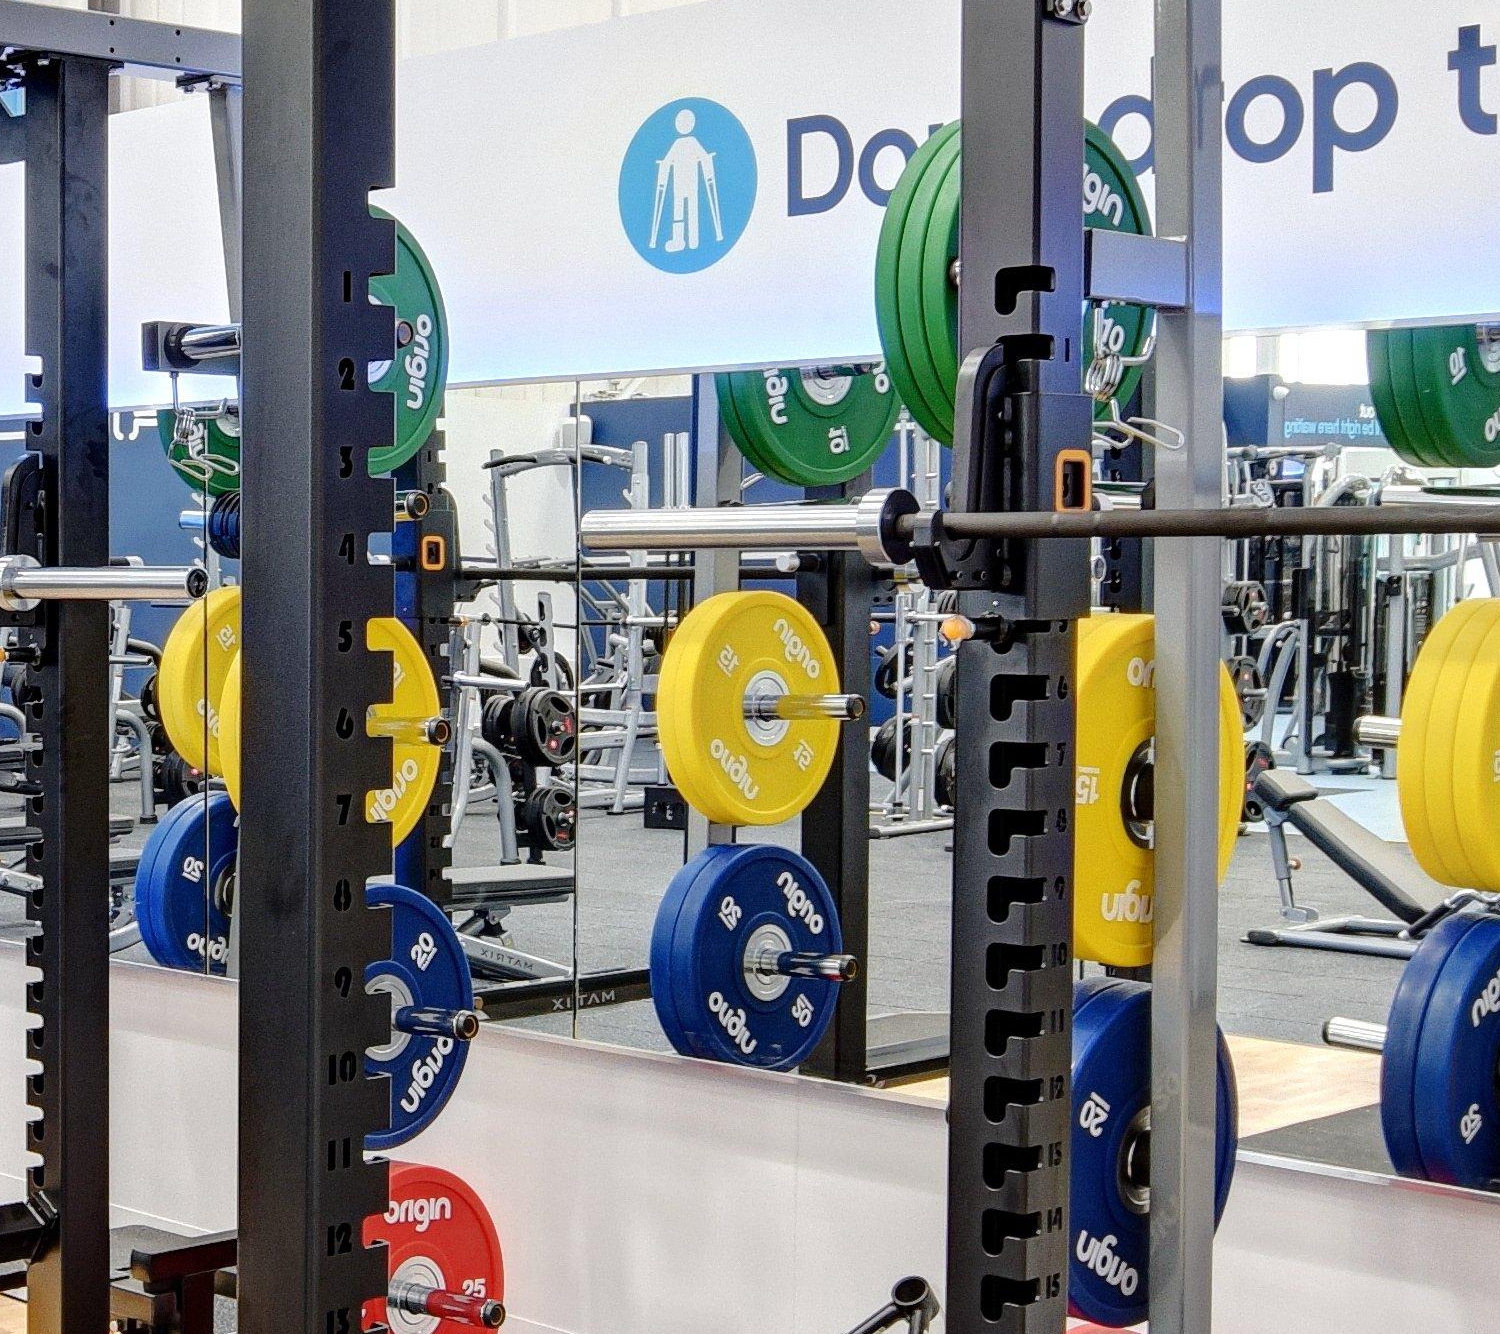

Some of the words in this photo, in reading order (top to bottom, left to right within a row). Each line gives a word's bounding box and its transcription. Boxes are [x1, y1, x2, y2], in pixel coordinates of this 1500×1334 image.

[1104, 55, 1399, 193] dop
[339, 358, 355, 390] 2
[404, 314, 433, 410] origin
[339, 446, 353, 478] 3
[339, 533, 355, 565] 4
[338, 621, 352, 652] 5
[336, 708, 354, 739] 6
[336, 794, 352, 825] 7
[333, 879, 351, 911] 8
[411, 932, 437, 971] 20
[334, 966, 351, 998] 9
[328, 1050, 357, 1085] 10
[400, 1037, 454, 1113] origin
[327, 1138, 351, 1171] 11
[384, 1196, 452, 1233] origin
[327, 1222, 353, 1257] 12
[1076, 1229, 1139, 1297] origin
